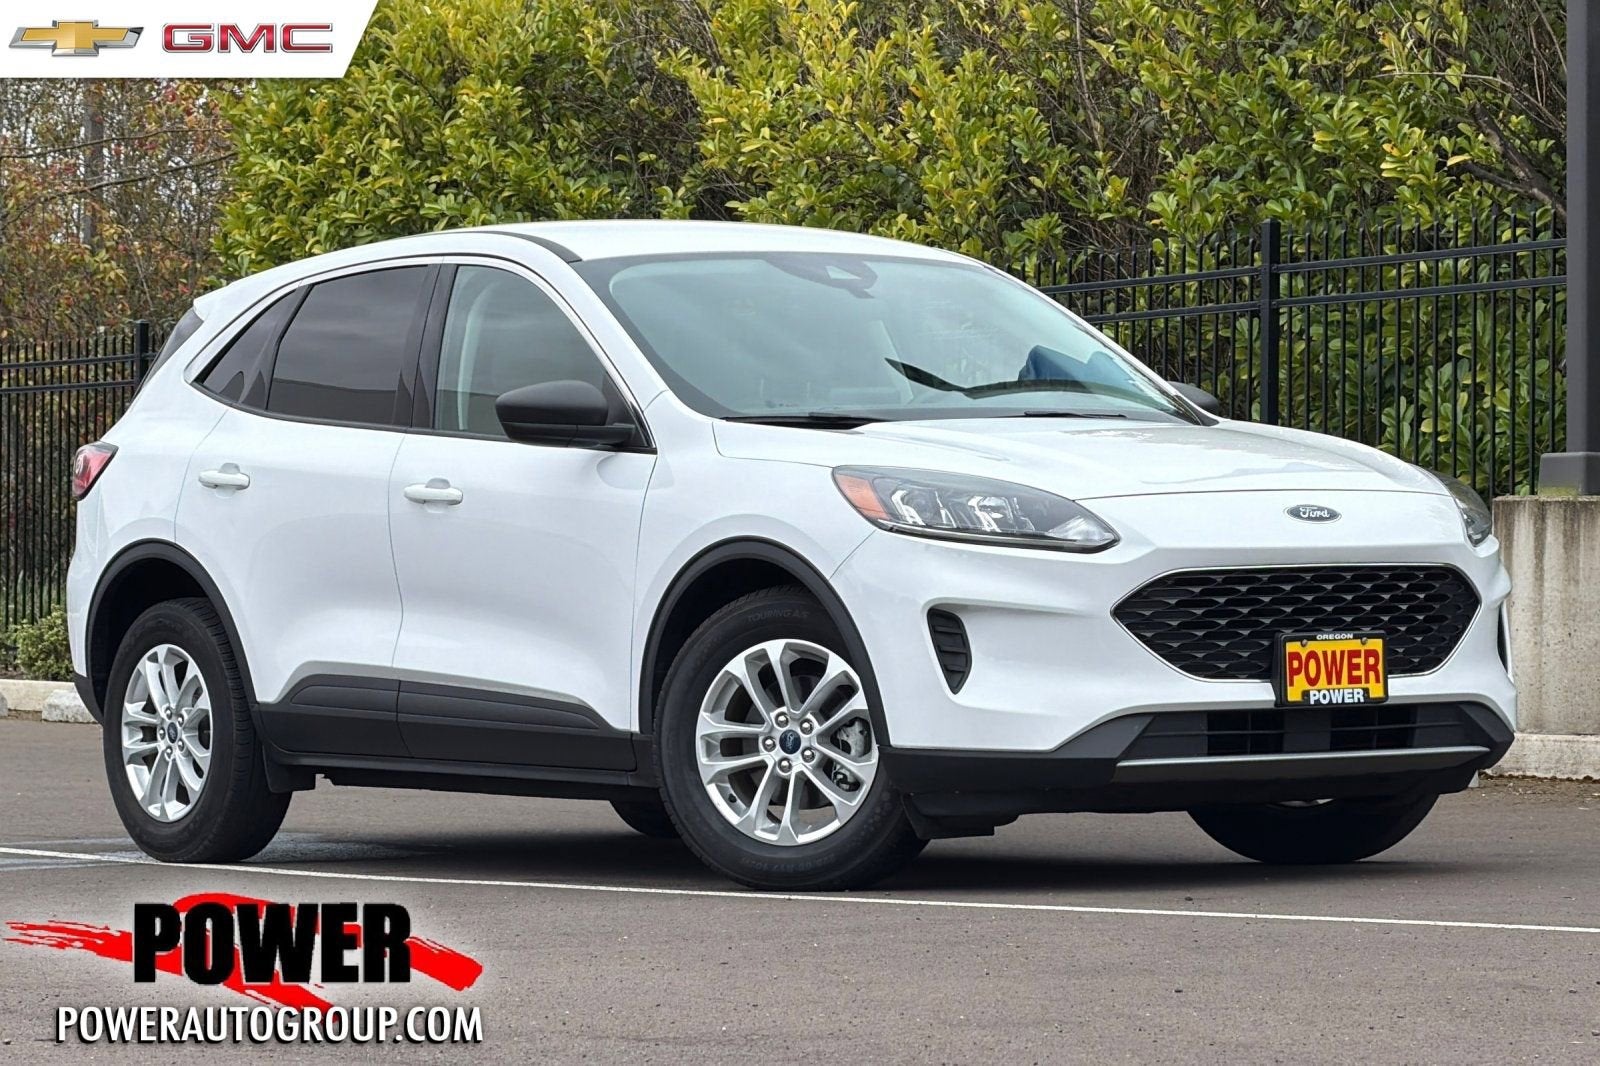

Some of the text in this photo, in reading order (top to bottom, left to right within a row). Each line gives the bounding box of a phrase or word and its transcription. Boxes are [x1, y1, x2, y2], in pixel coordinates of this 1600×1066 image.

[1299, 506, 1331, 518] Ford
[1316, 633, 1354, 641] OREGON
[1287, 648, 1381, 687] POWER
[1309, 688, 1365, 705] POWER
